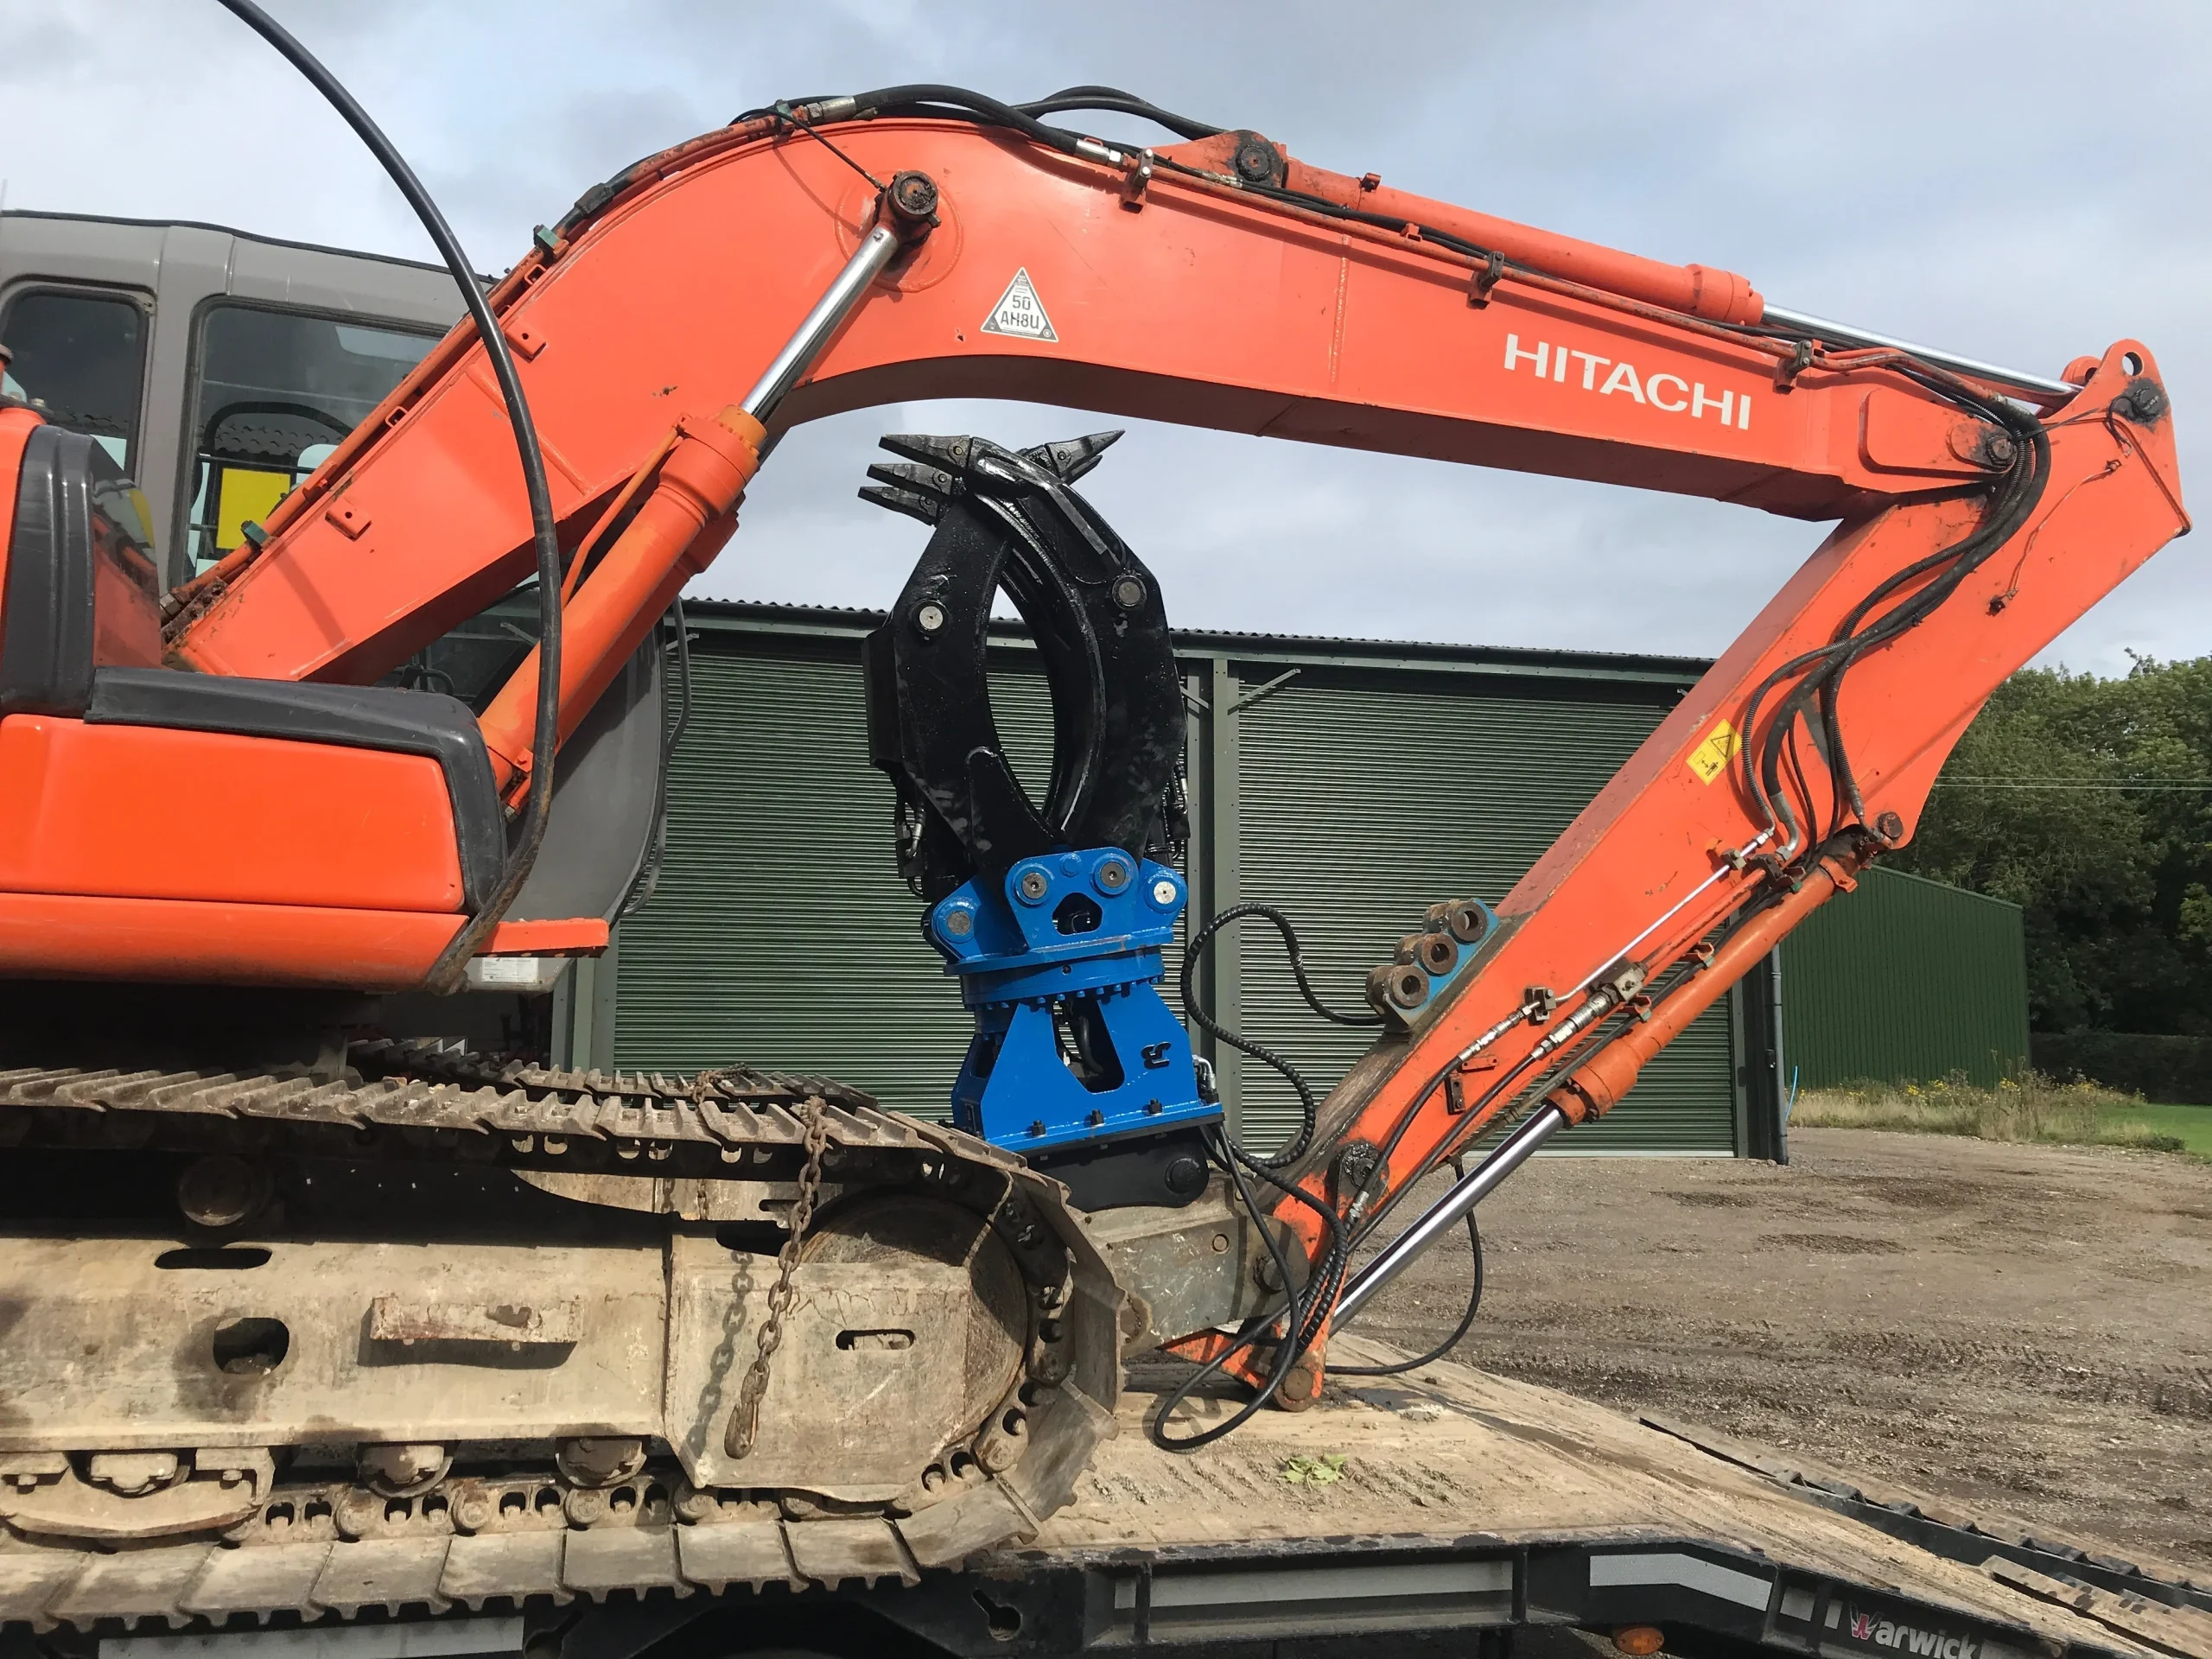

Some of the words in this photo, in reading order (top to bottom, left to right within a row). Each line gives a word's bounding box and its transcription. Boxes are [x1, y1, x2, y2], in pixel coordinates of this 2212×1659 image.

[1001, 311, 1039, 329] AH8U
[1504, 334, 1751, 430] HITACHI
[1849, 1601, 1977, 1659] Warwick
